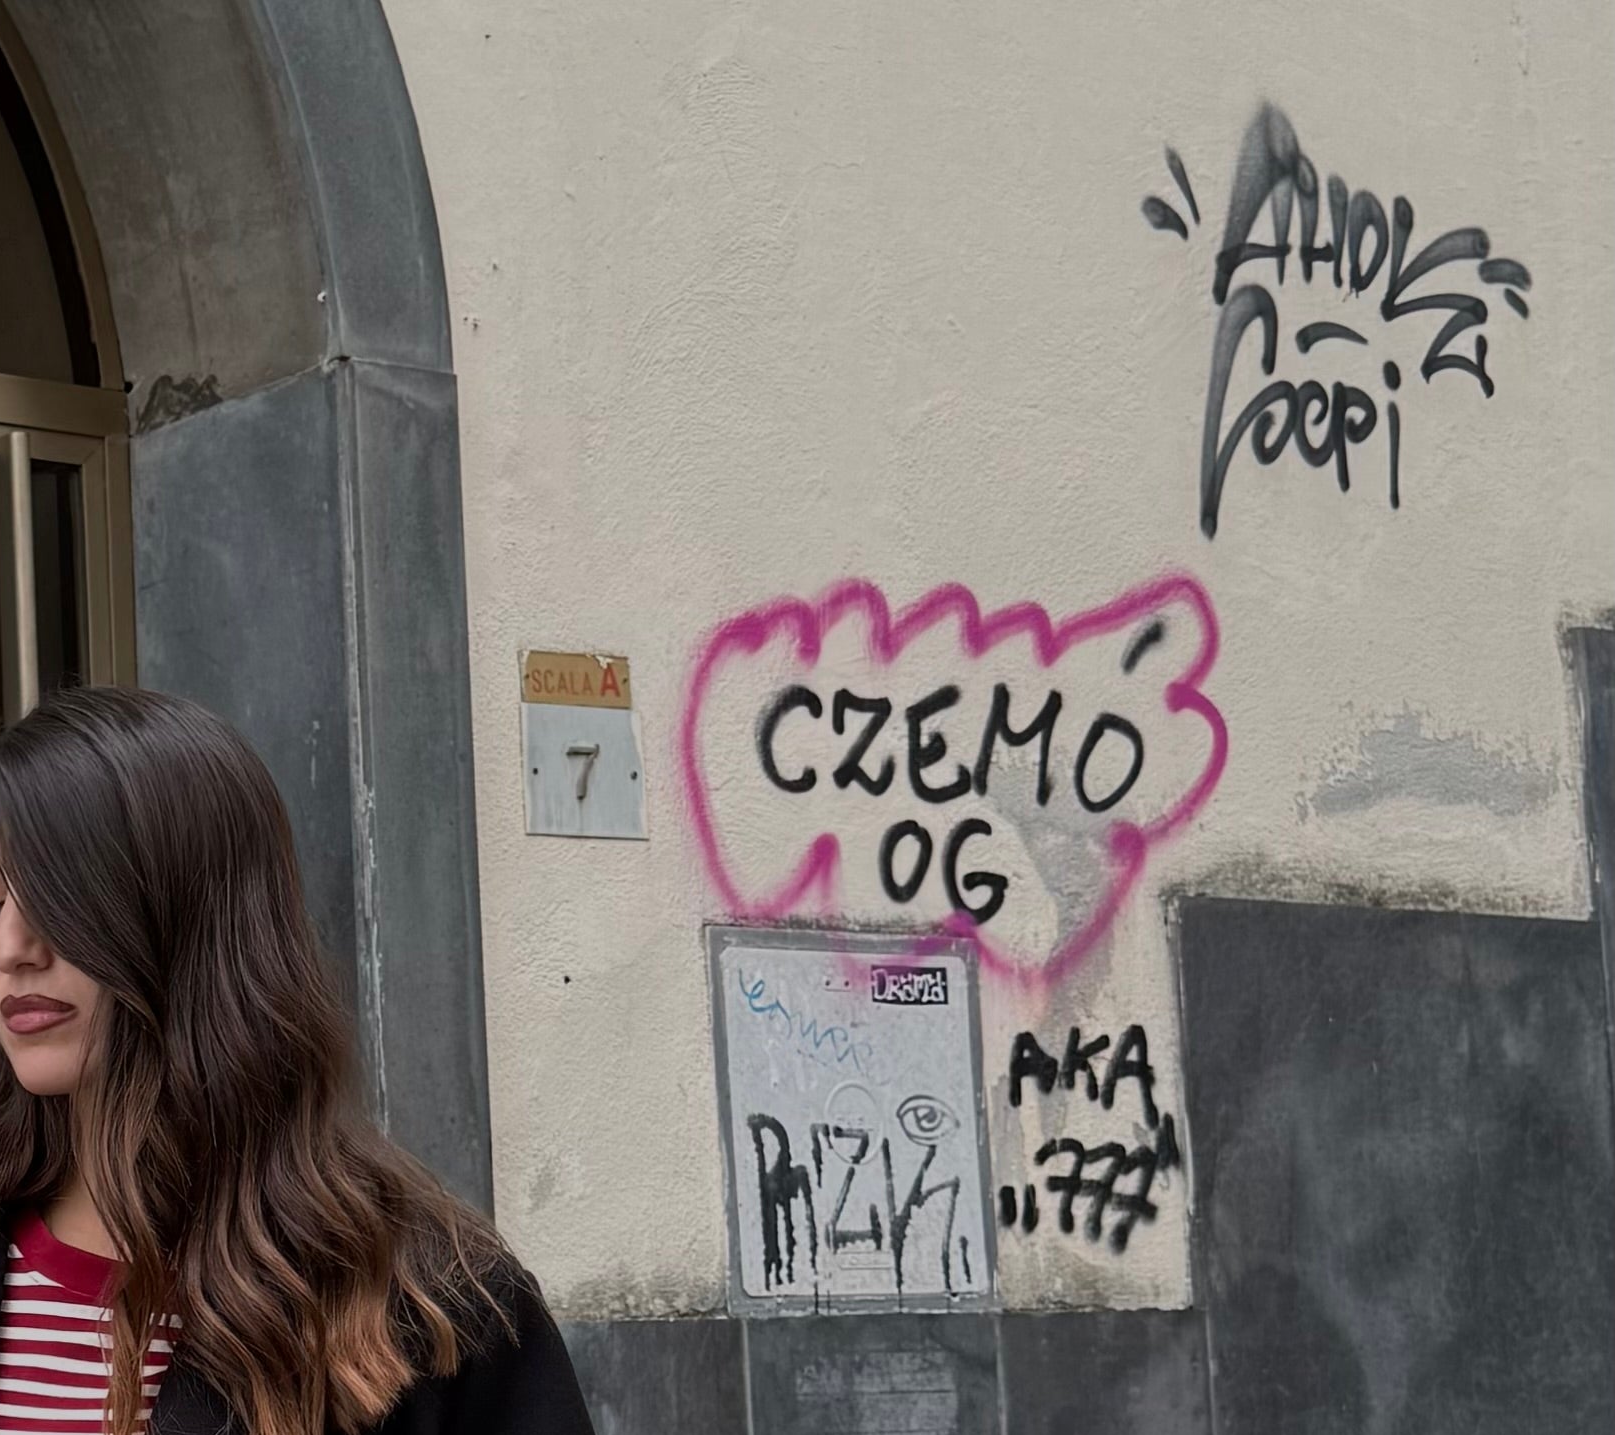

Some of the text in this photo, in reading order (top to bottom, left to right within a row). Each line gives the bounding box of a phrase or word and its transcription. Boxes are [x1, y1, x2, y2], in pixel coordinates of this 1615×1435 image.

[532, 665, 621, 697] SCALA A
[566, 743, 600, 801] 7
[756, 682, 1145, 814] CZEMO
[879, 817, 1010, 927] OG
[1010, 1024, 1159, 1130] AKA
